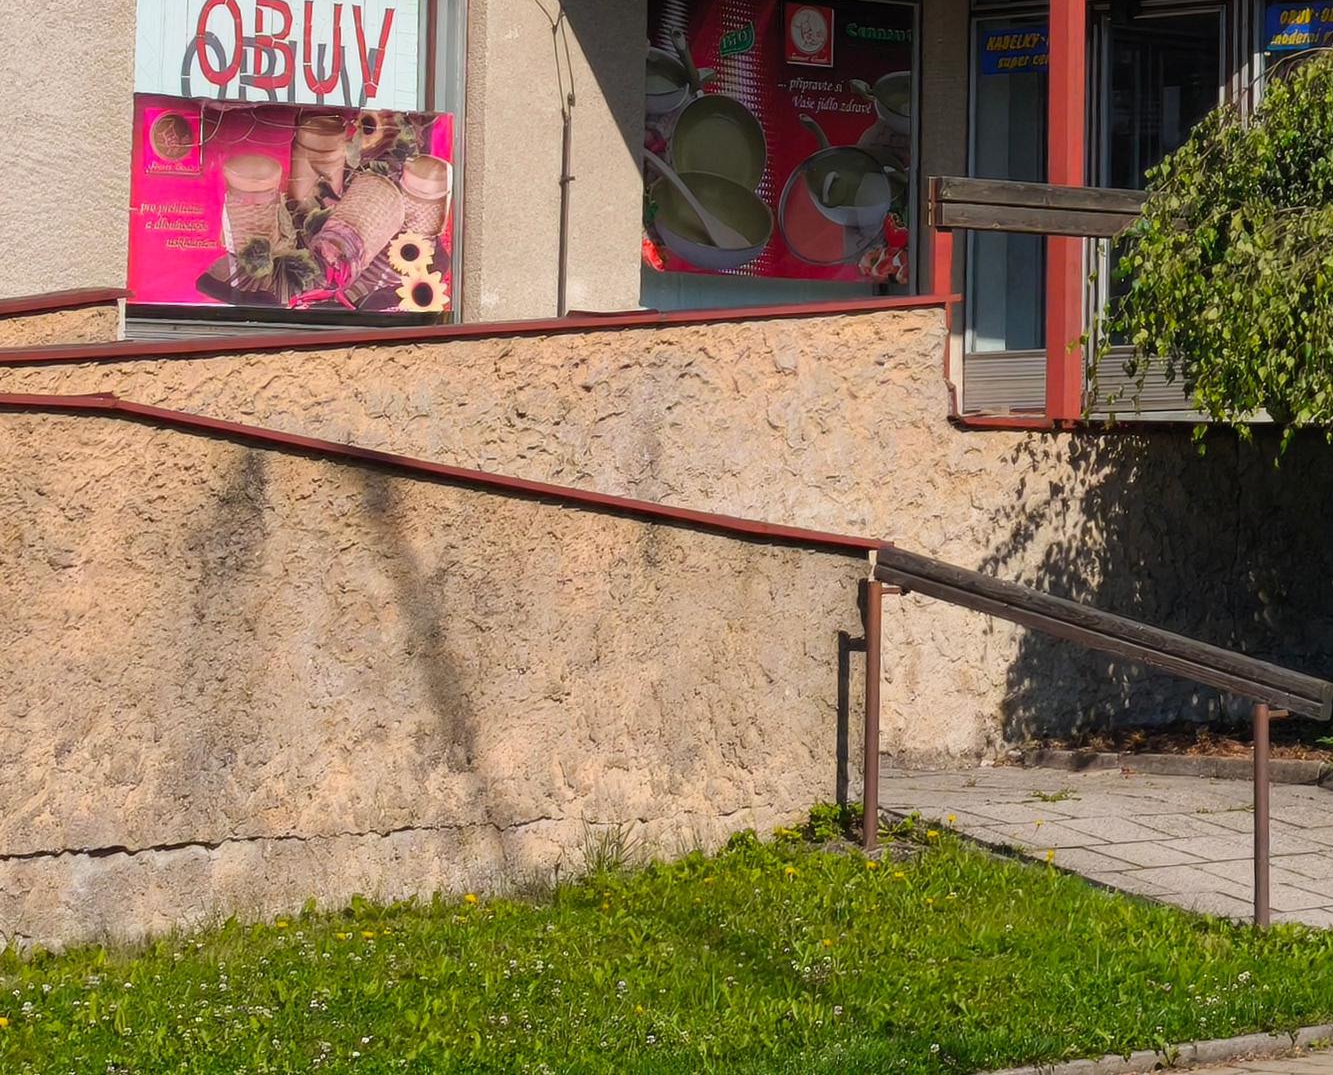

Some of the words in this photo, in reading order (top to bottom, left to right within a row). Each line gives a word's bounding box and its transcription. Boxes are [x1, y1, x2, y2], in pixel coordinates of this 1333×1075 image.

[789, 77, 834, 92] připravte
[835, 81, 843, 93] si
[793, 95, 814, 109] Vaše
[816, 97, 838, 114] jídlo
